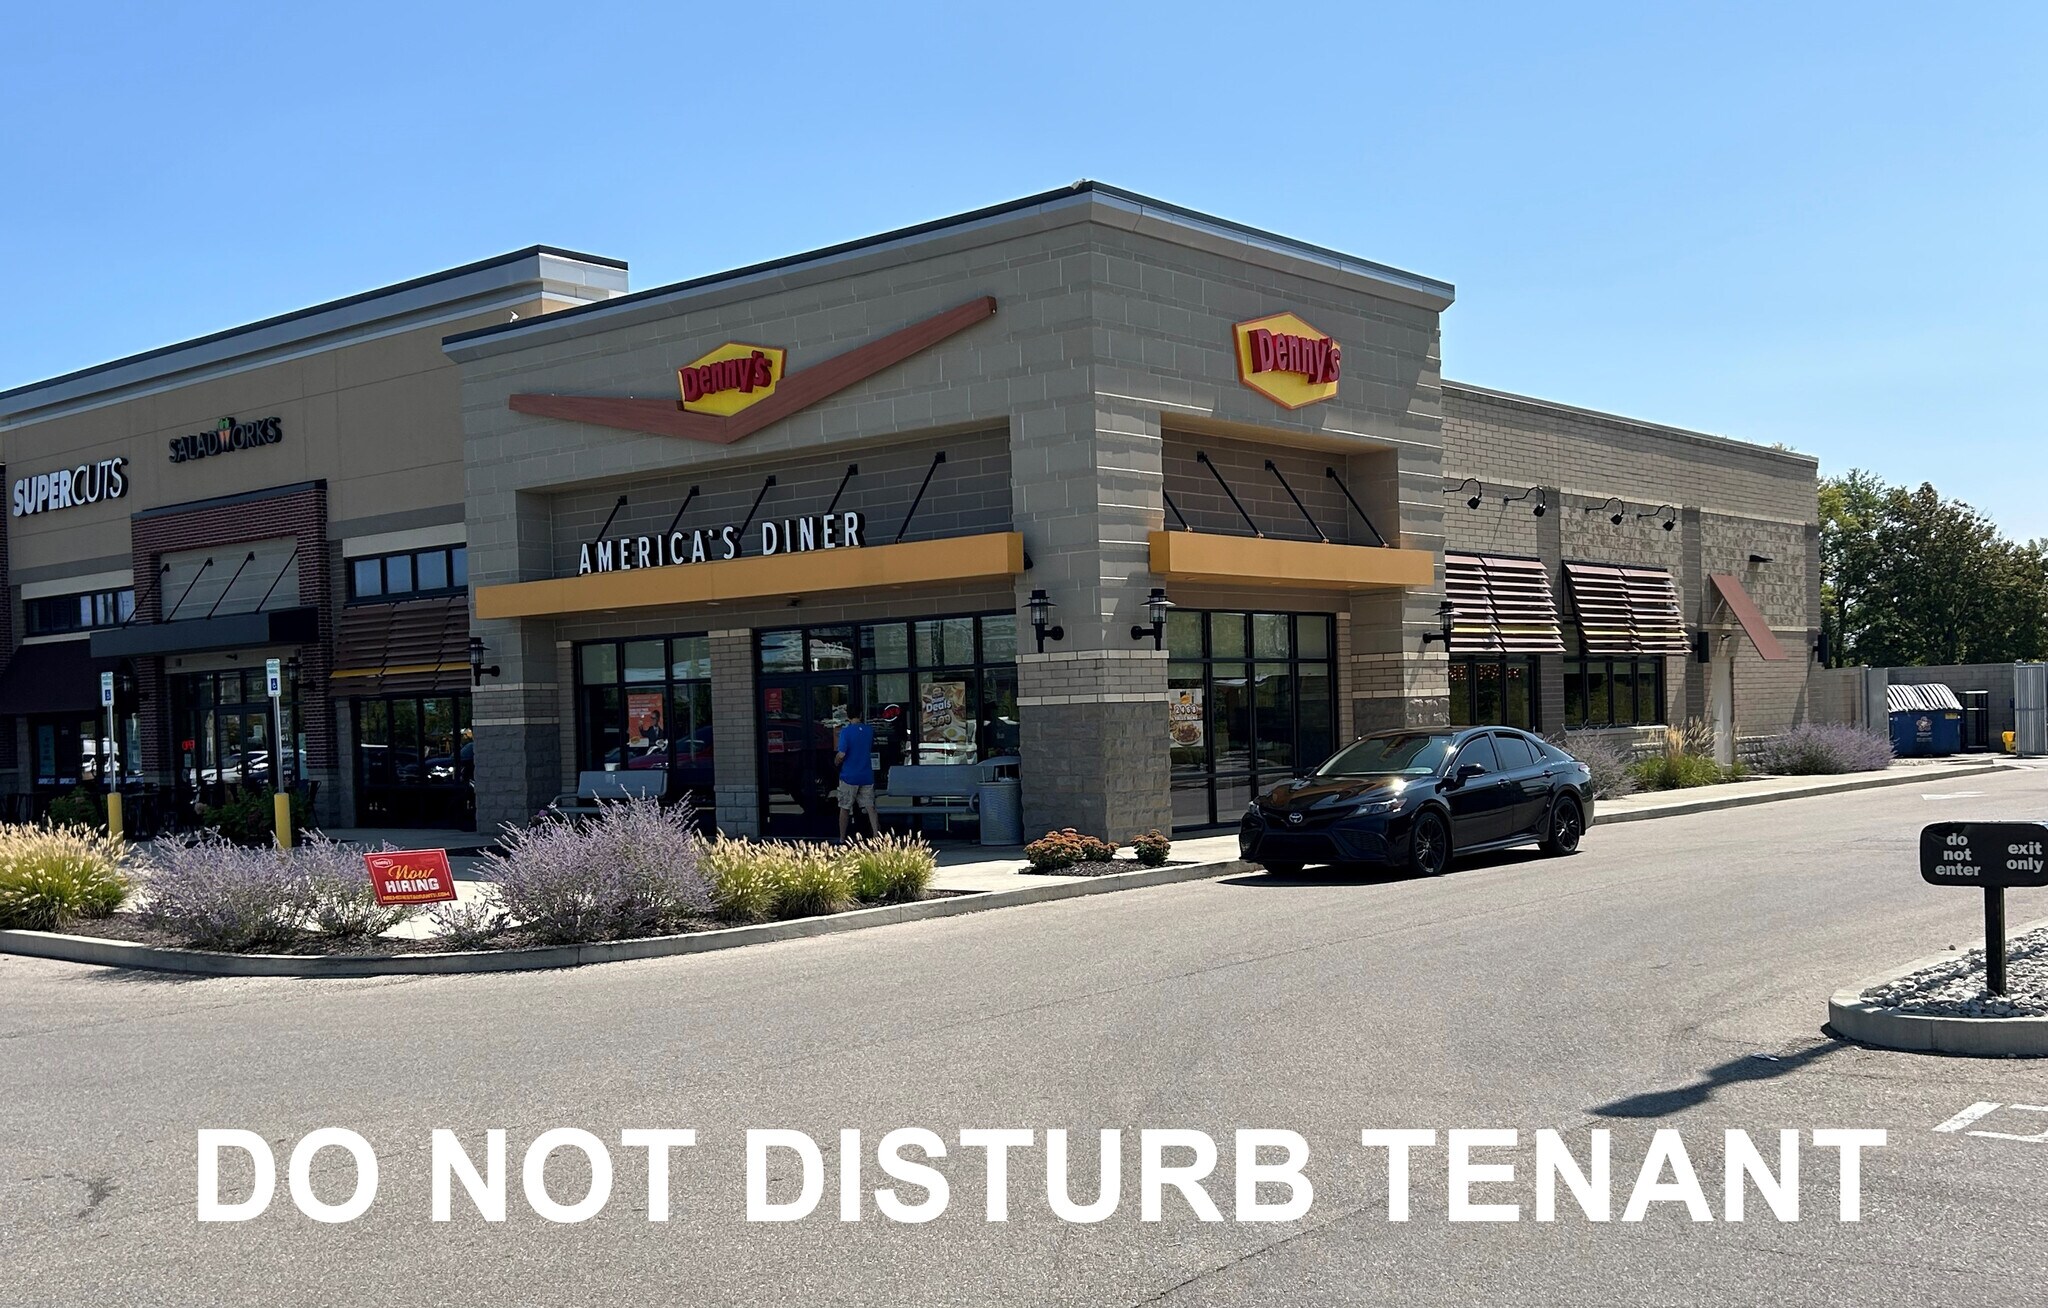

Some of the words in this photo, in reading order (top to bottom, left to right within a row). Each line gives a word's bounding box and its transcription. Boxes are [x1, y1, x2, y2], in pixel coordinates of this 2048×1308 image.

[1248, 328, 1341, 385] Denny's
[682, 350, 773, 402] Denny's
[169, 417, 281, 463] SALADWORKS
[13, 457, 125, 517] SUPERCUTS
[579, 526, 735, 575] AMERICA'S
[762, 511, 861, 557] DINER
[926, 701, 951, 713] Deals
[1946, 833, 1968, 846] do
[1943, 848, 1972, 861] not
[2007, 841, 2043, 855] exit
[388, 865, 434, 879] Now
[1935, 863, 1981, 876] enter
[2006, 857, 2044, 873] only
[385, 878, 440, 893] HIRING
